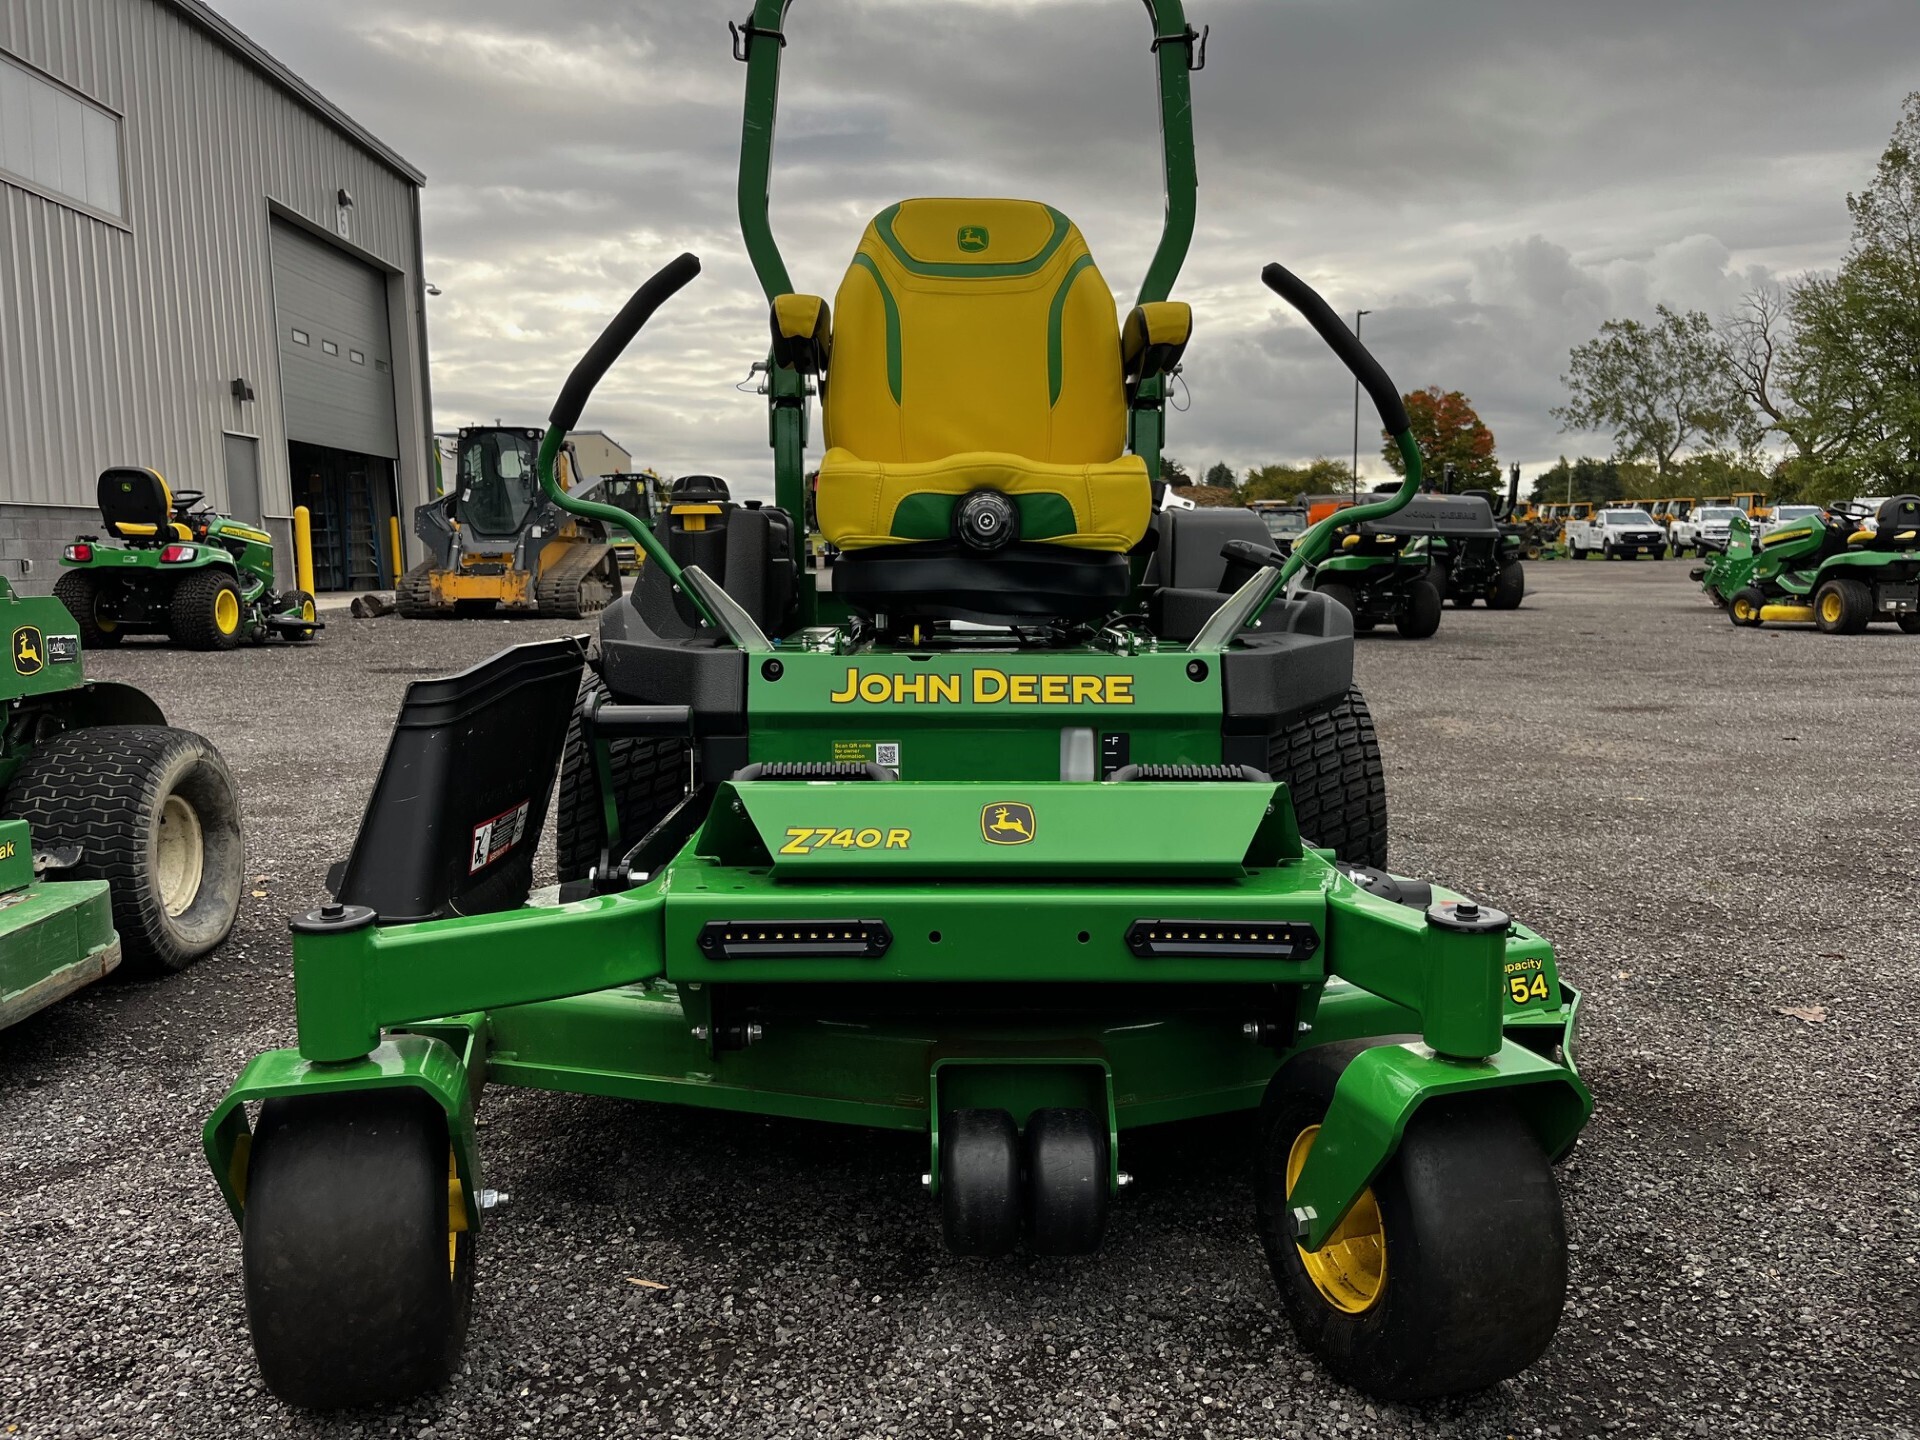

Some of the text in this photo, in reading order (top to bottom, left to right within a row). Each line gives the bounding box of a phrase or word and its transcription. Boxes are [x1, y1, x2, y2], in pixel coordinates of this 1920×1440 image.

[830, 667, 1135, 705] JOHN DEERE
[1509, 972, 1549, 1003] 54
